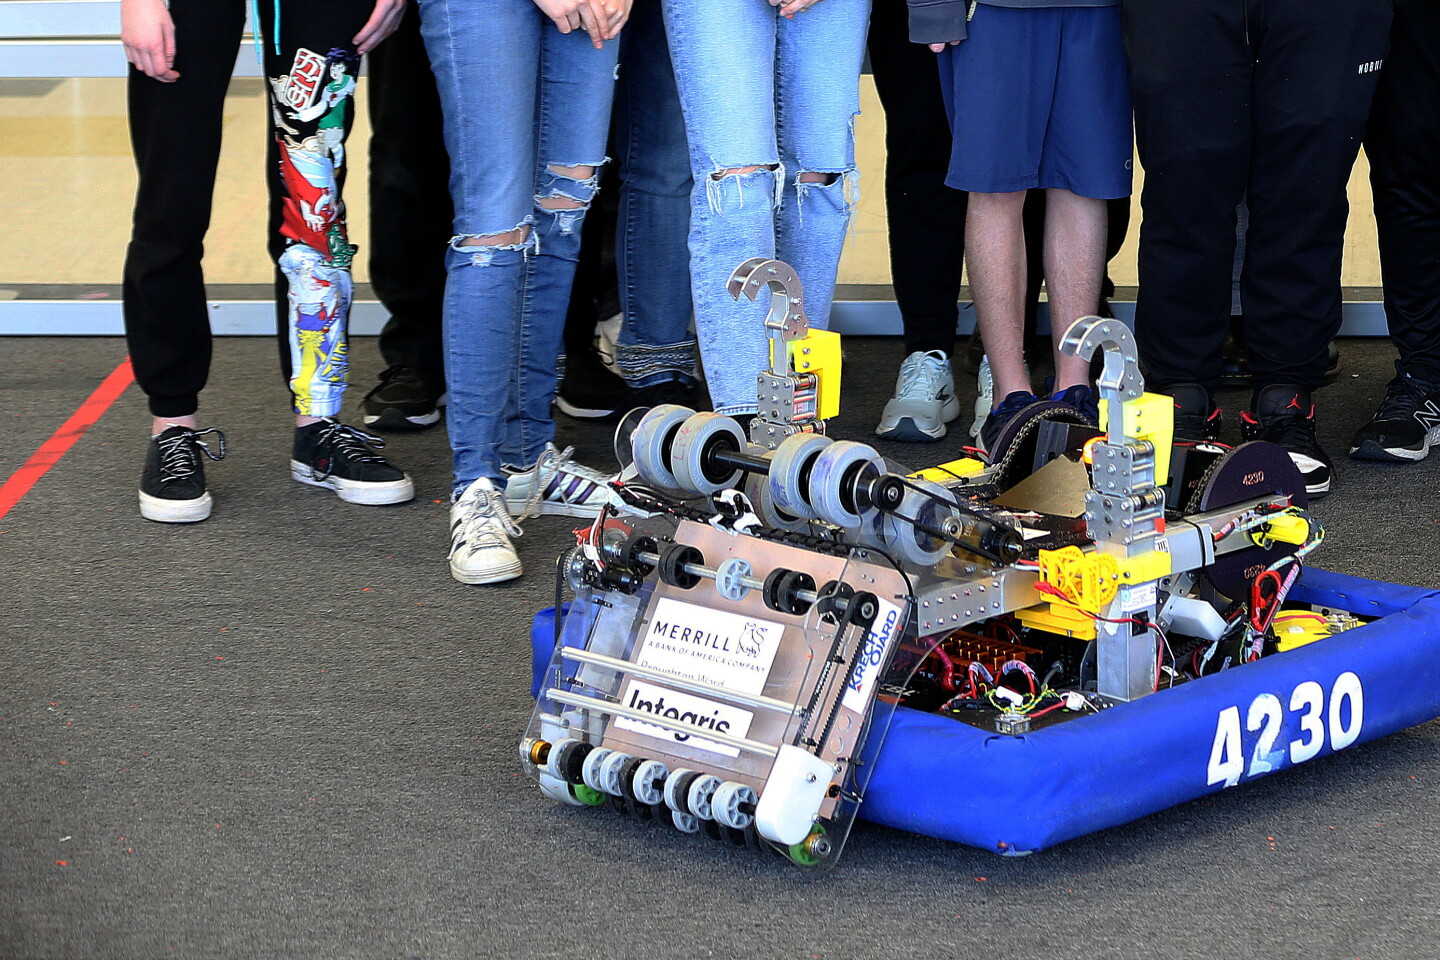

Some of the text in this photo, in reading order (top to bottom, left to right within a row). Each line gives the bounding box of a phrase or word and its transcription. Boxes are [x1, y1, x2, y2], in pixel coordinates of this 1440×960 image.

[1242, 470, 1265, 486] 4230
[653, 621, 730, 652] MERRILL
[655, 642, 676, 653] BANK
[678, 647, 688, 655] OF
[690, 651, 726, 664] AMERICA
[727, 660, 765, 673] COMPANY
[624, 690, 731, 743] Integris
[1207, 671, 1364, 789] 4230
